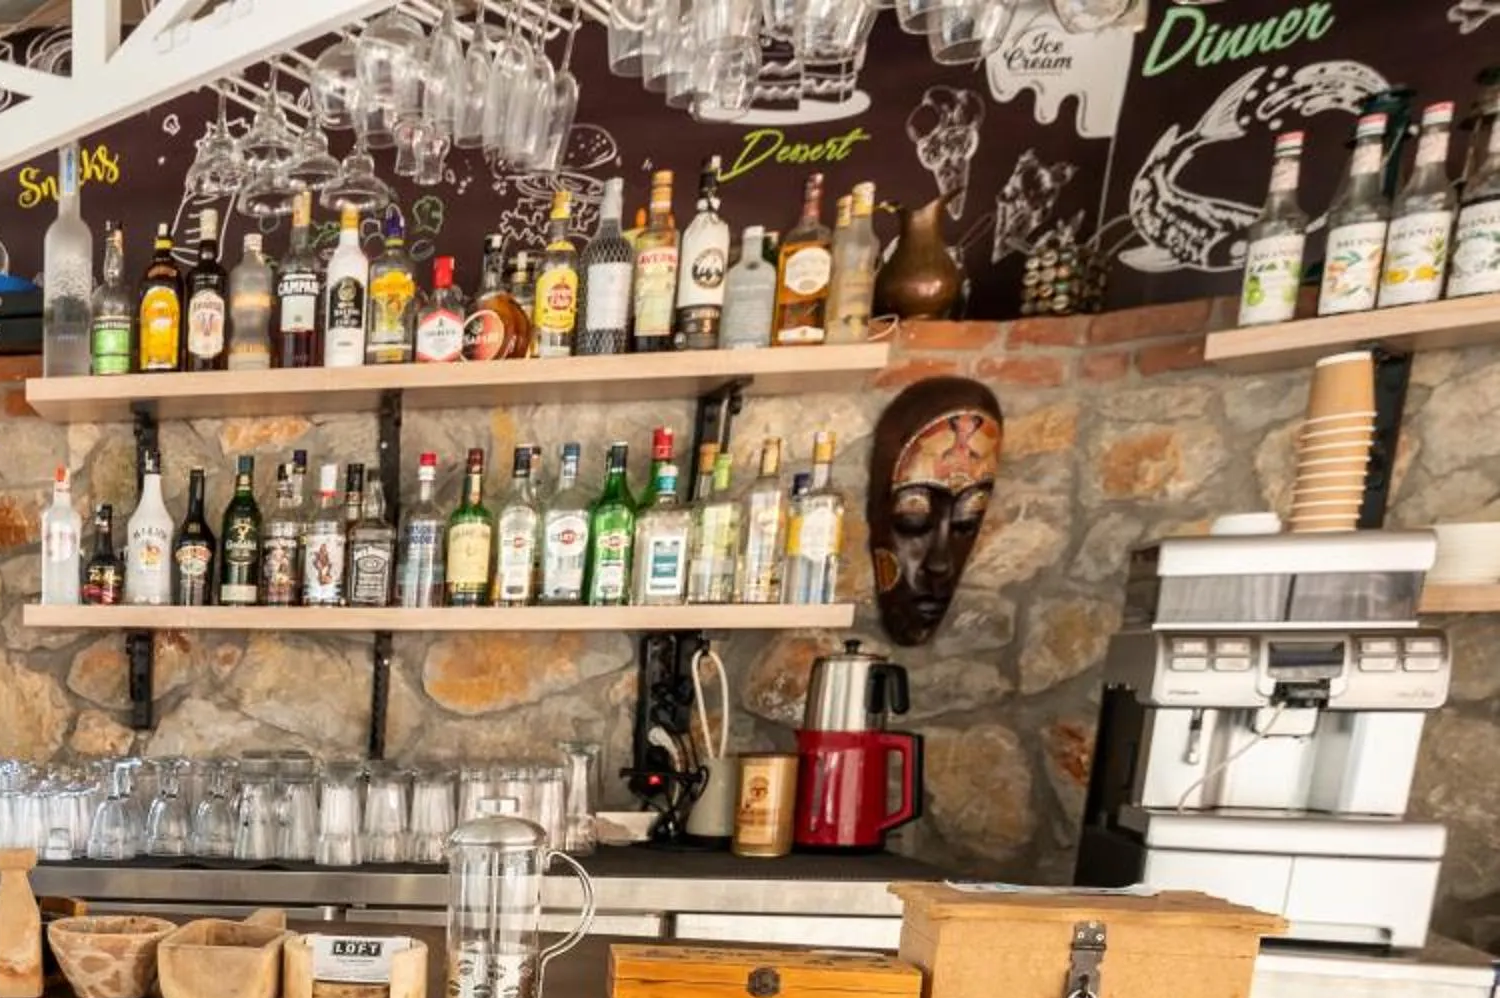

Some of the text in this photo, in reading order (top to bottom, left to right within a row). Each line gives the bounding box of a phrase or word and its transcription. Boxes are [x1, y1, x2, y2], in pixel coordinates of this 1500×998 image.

[1030, 31, 1063, 53] Ice
[1142, 2, 1335, 76] Dinner
[1003, 50, 1073, 71] Cream
[19, 145, 119, 208] Snks
[334, 942, 379, 954] LOFT
